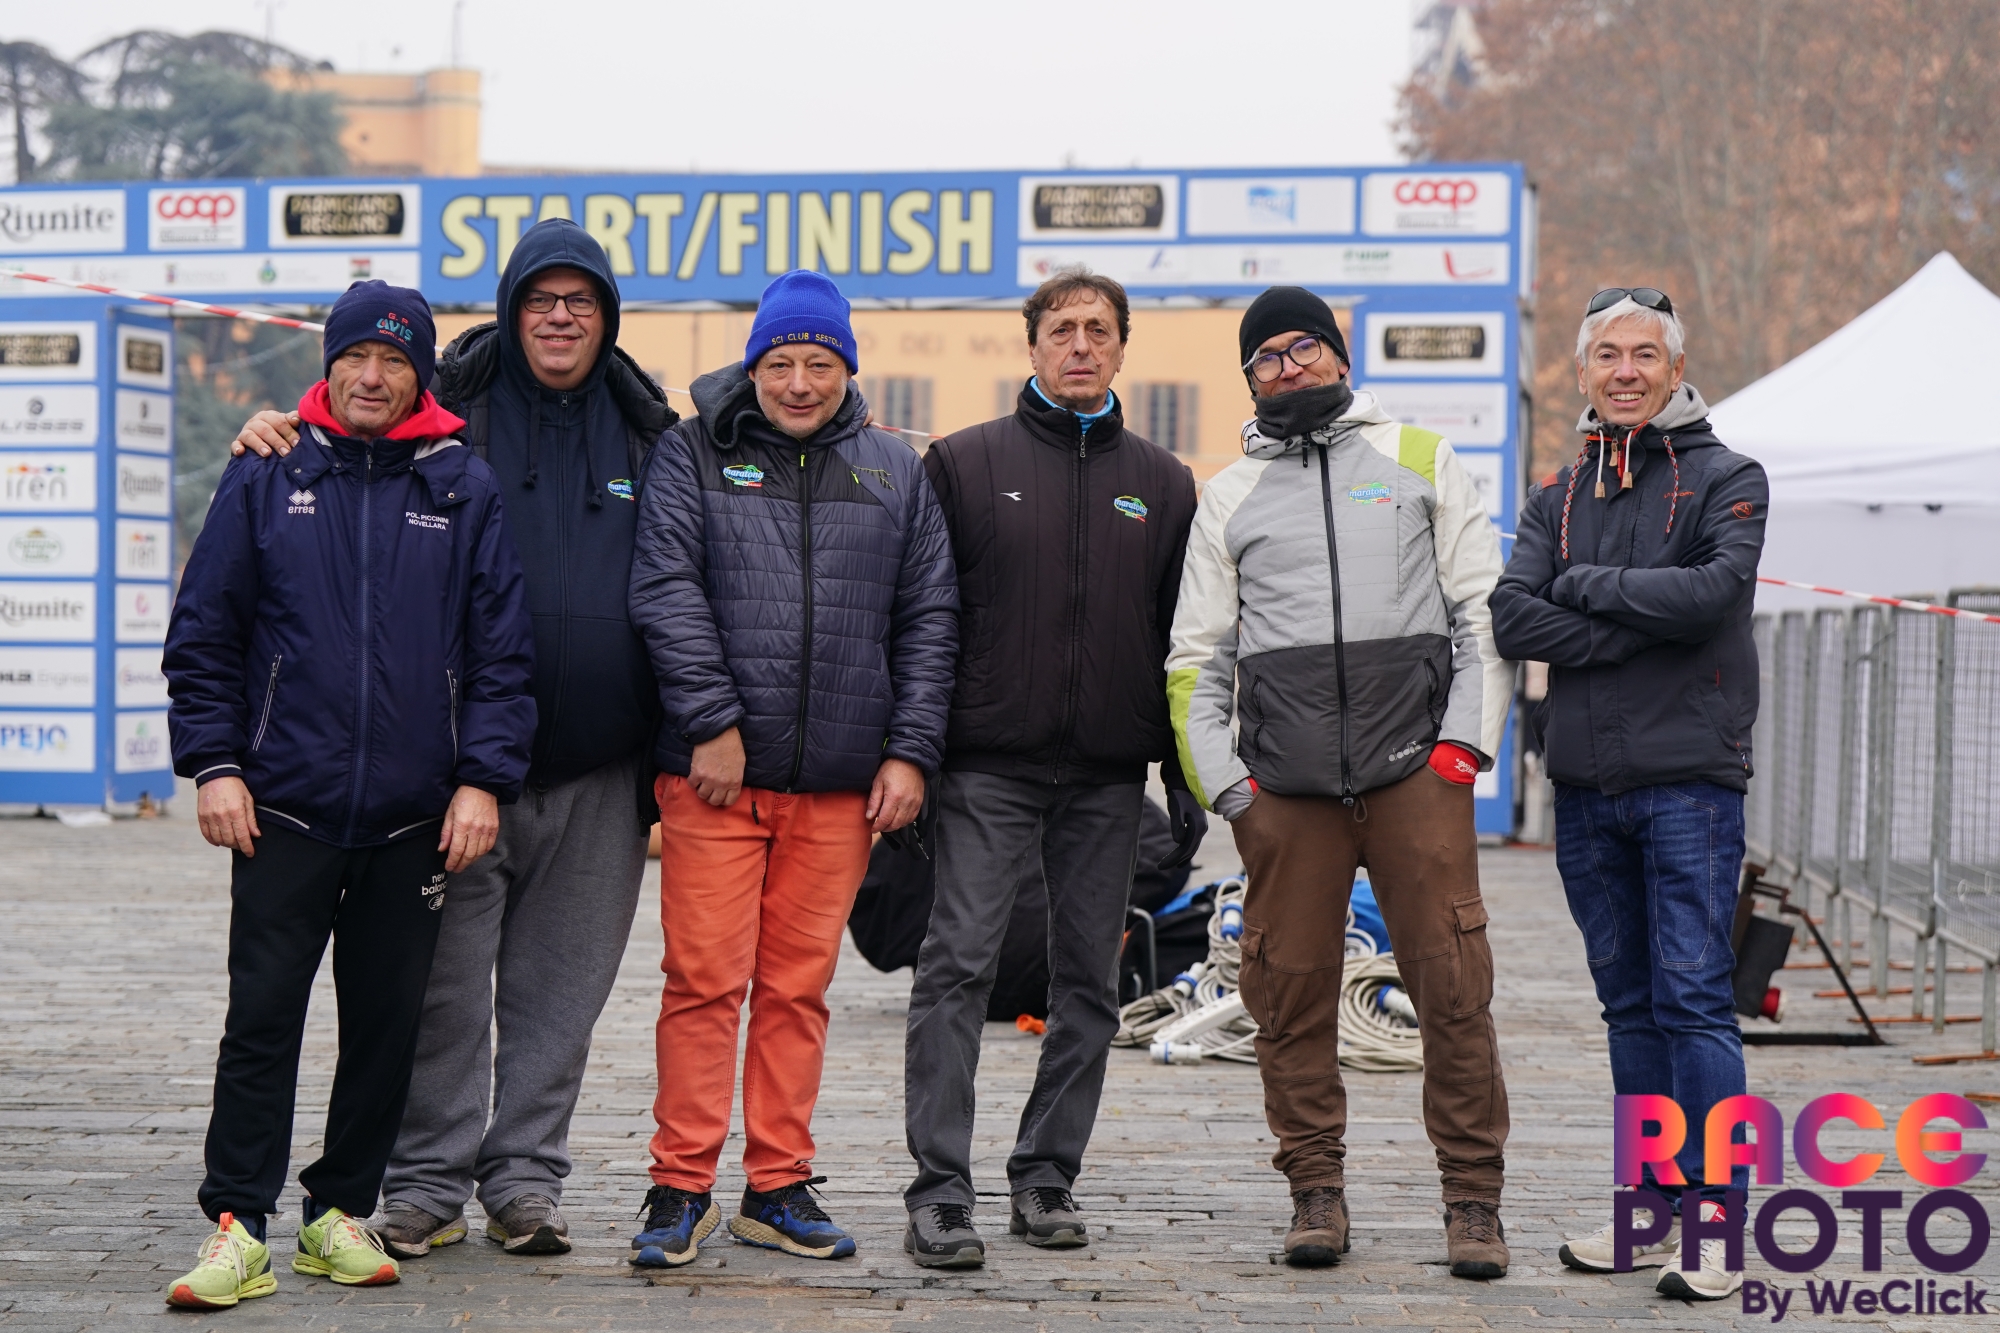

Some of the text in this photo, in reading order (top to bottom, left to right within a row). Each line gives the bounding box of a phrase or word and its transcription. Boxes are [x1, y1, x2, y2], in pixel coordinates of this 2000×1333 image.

[290, 194, 399, 215] PARMIGIANO
[1040, 186, 1157, 207] PARMIGIANO
[1394, 180, 1477, 210] coop
[157, 194, 236, 226] coop
[1050, 205, 1146, 227] REGGIANO
[301, 214, 390, 235] REGGIANO
[771, 332, 843, 348] SCI CLUB SESTOLA
[722, 467, 765, 479] maratona
[6, 475, 68, 500] iren
[1349, 487, 1390, 498] maratona
[1114, 498, 1148, 515] maratona
[408, 518, 447, 530] NOVELLARA
[420, 514, 449, 525] PICCININI
[421, 880, 448, 896] balanc
